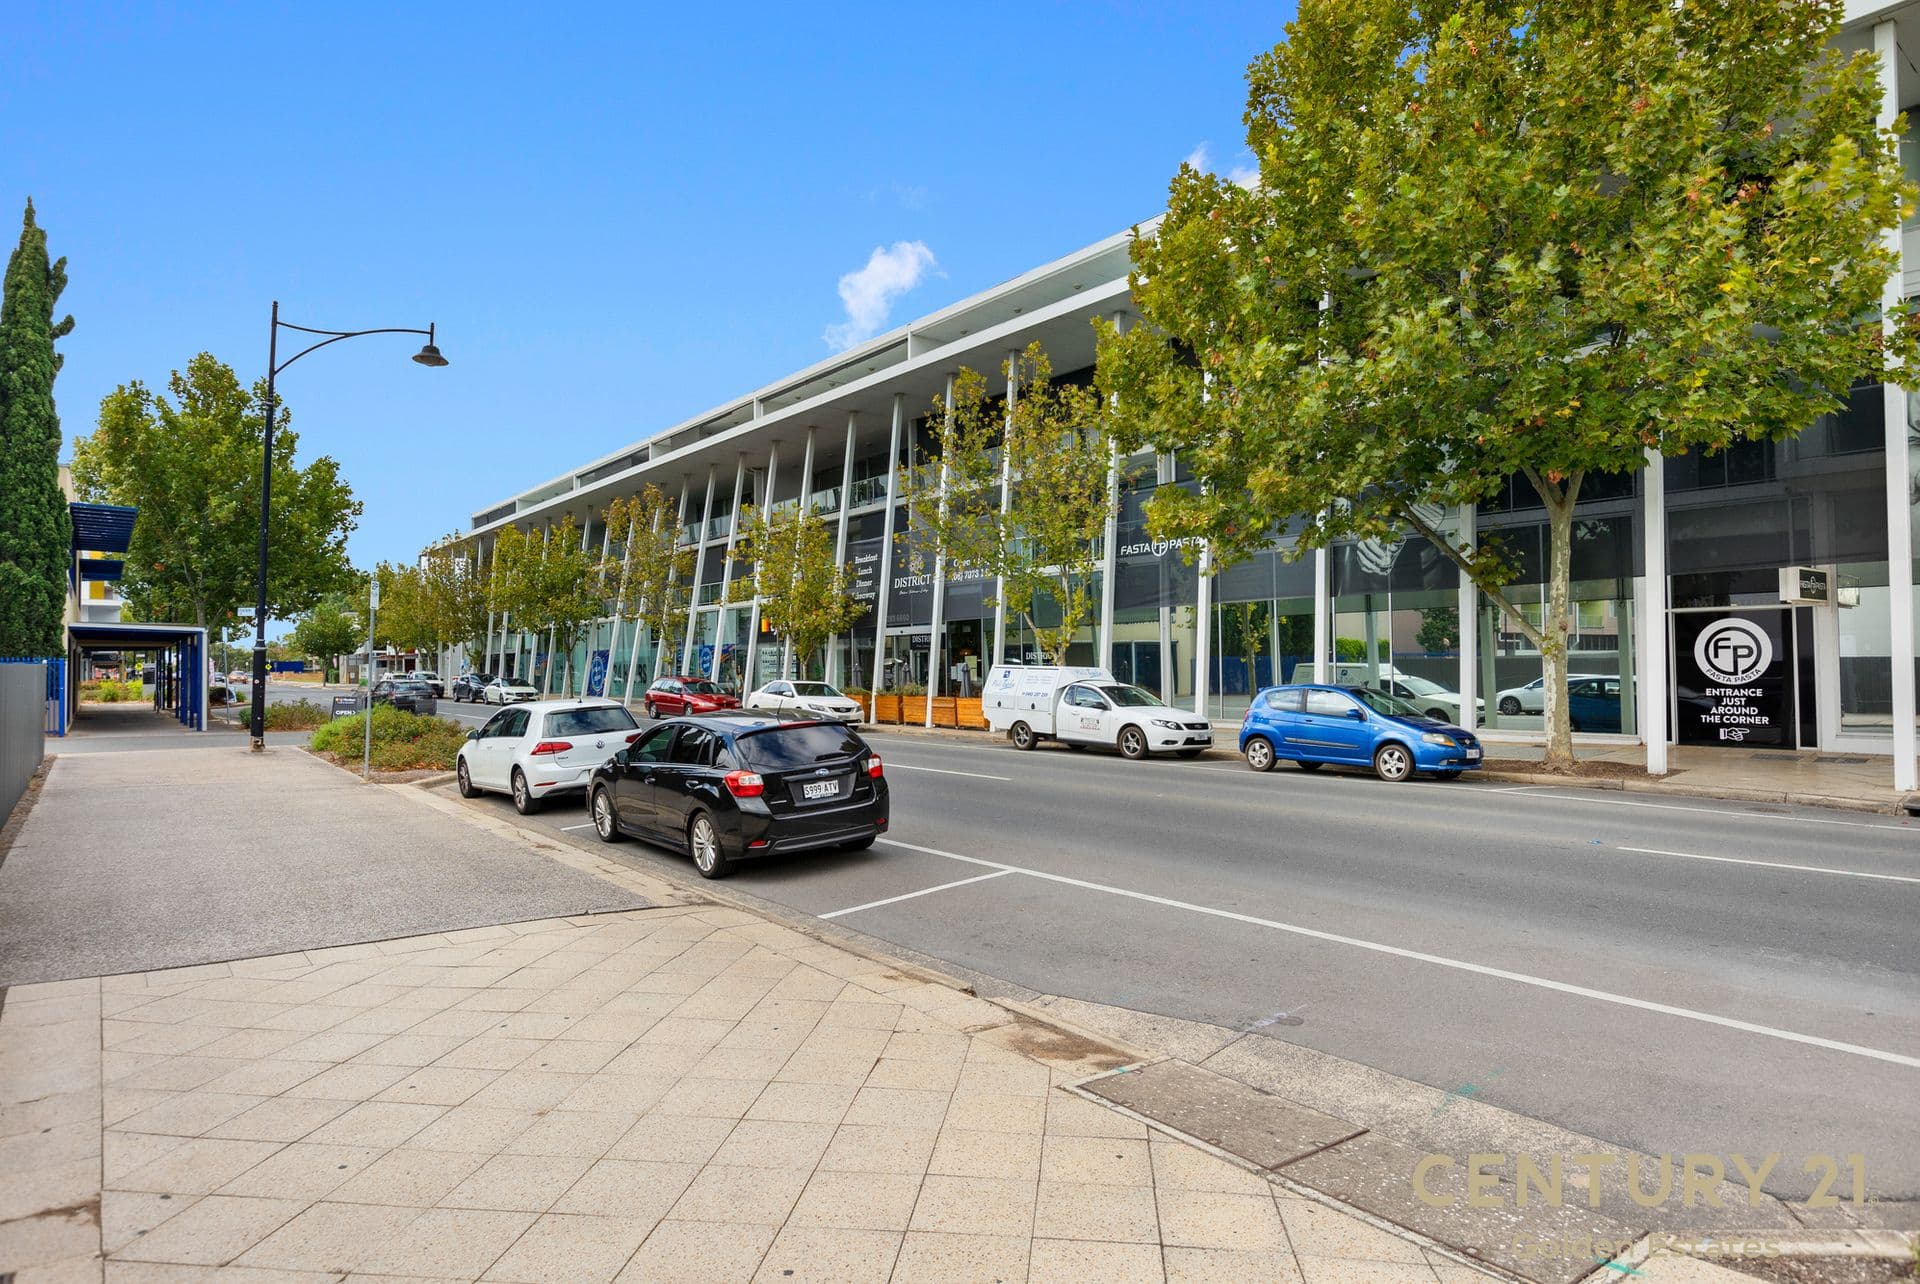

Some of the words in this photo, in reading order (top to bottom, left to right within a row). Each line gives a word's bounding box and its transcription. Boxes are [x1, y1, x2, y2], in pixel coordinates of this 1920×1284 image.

[1120, 543, 1151, 556] FASTA
[894, 573, 932, 589] DISTRICT
[1705, 668, 1732, 683] FASTA
[1735, 668, 1762, 683] PASTA
[1705, 688, 1763, 697] ENTRANCE
[1721, 697, 1747, 706] JUST
[1710, 706, 1759, 715] AROUND
[1700, 714, 1721, 723] THE
[1722, 715, 1770, 725] CORNER
[824, 782, 838, 793] ATV
